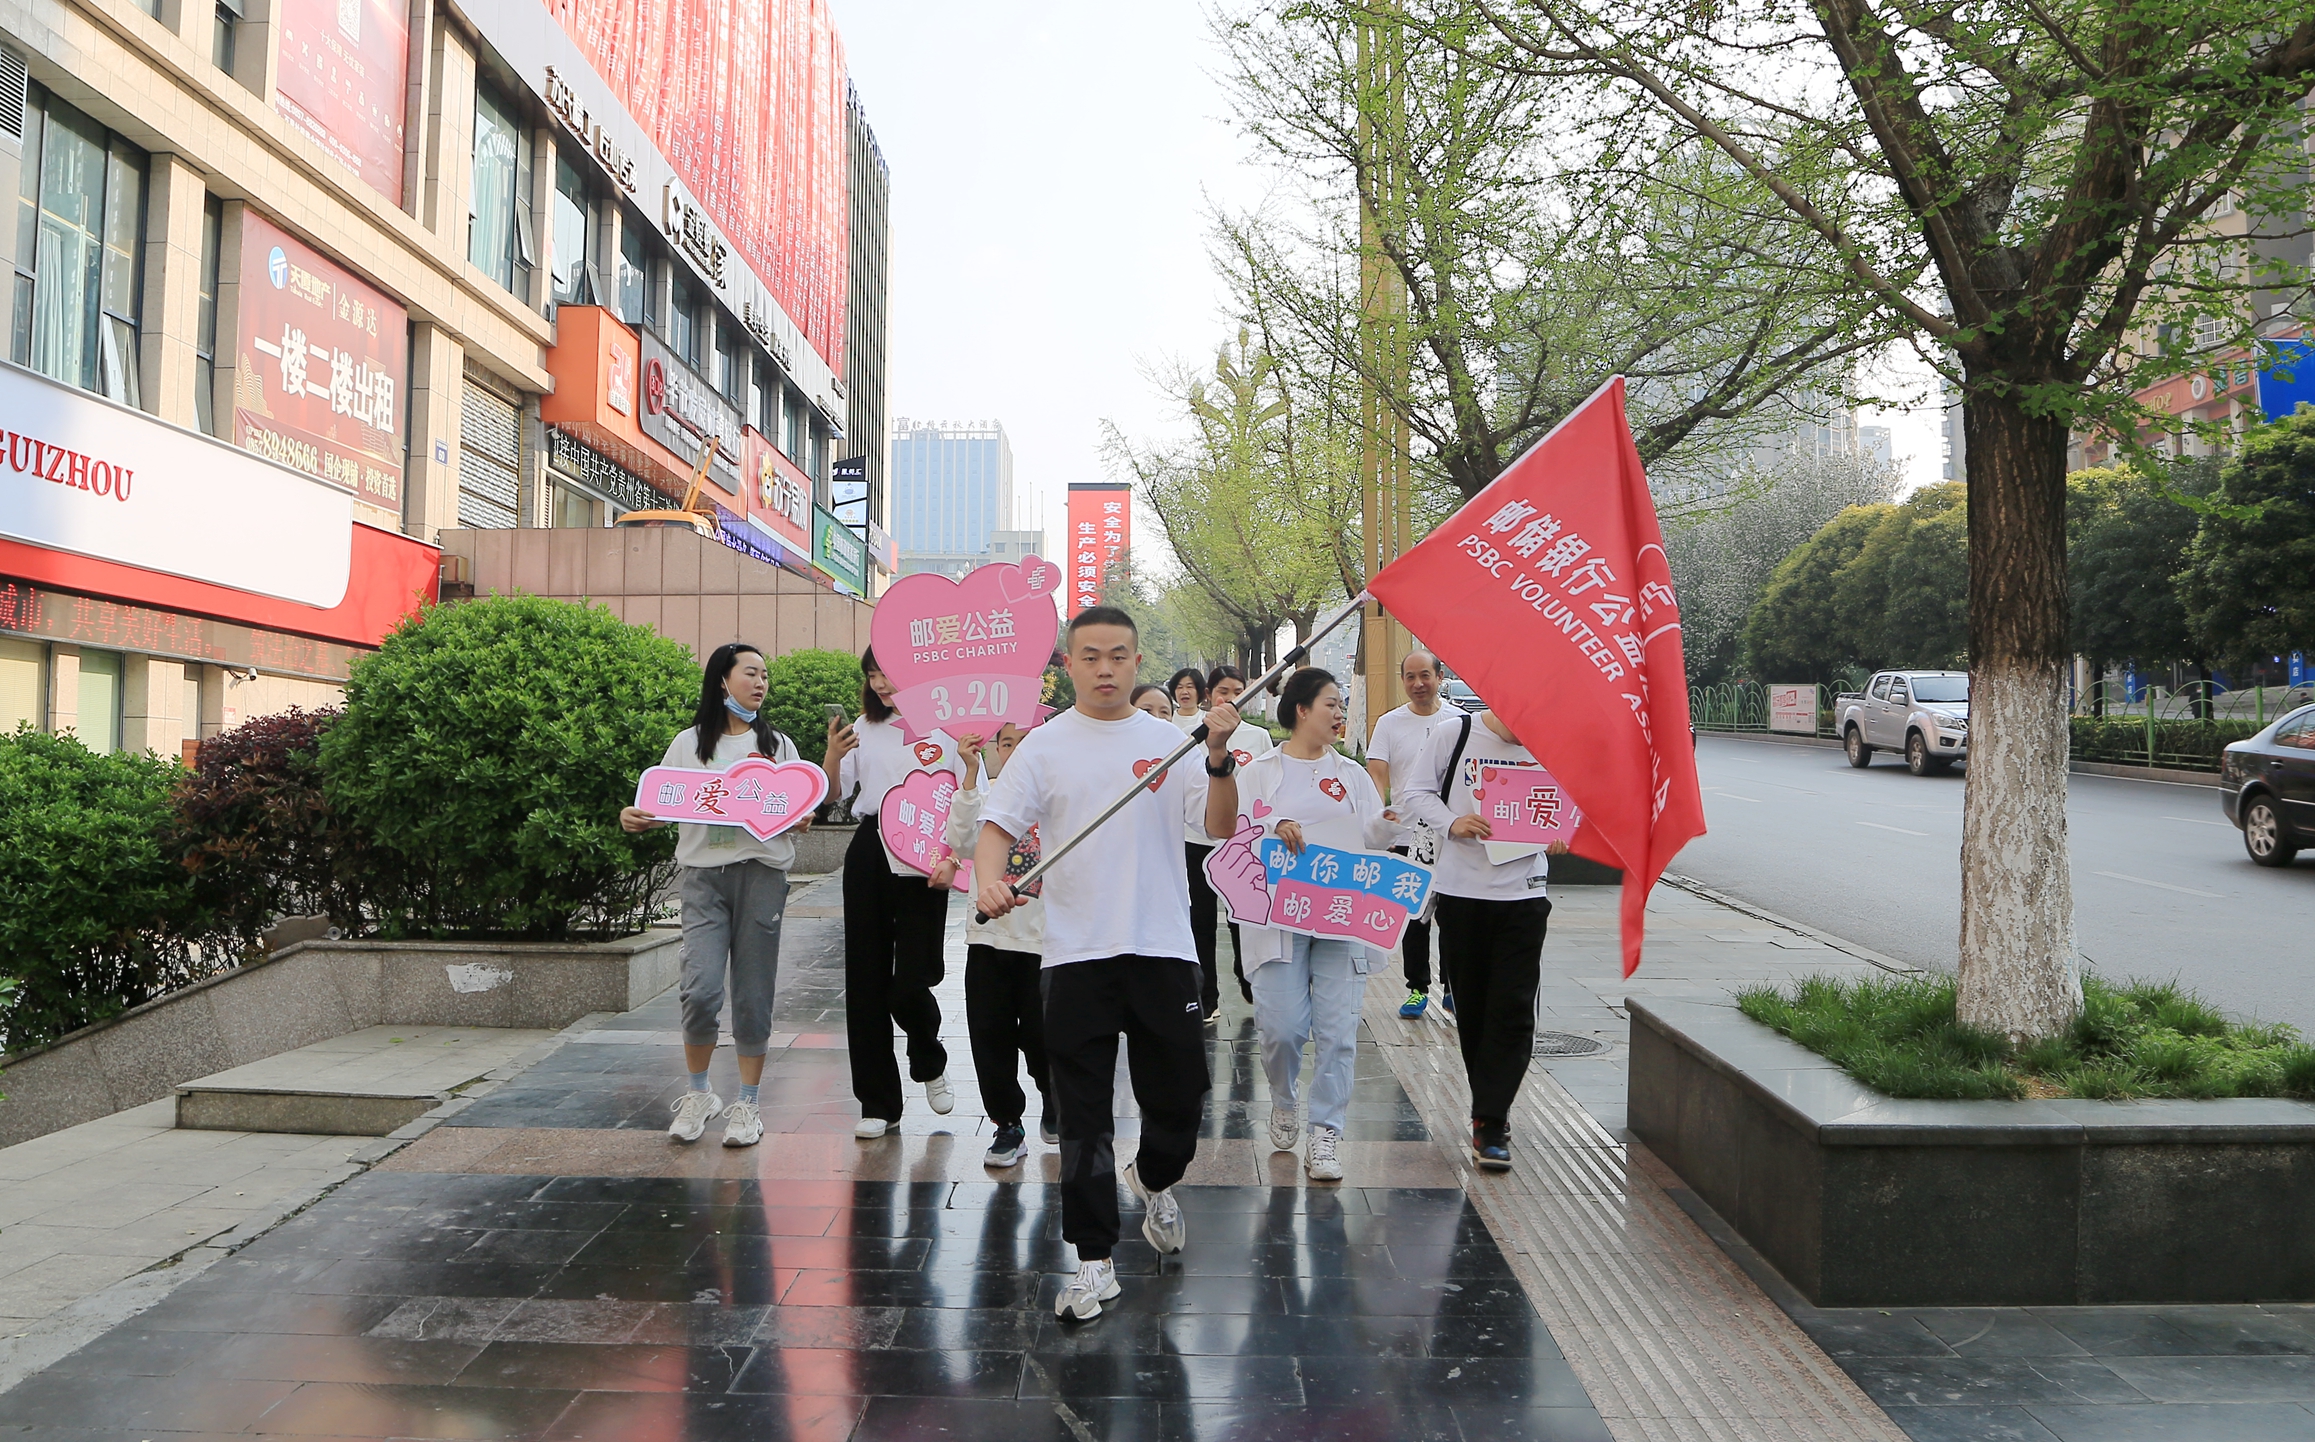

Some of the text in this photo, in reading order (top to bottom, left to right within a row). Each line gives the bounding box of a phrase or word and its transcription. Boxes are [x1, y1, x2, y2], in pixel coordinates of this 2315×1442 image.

[338, 292, 378, 339] 金源达
[254, 322, 395, 435] 一楼二楼出租
[0, 429, 134, 502] UIZHOU
[263, 428, 319, 475] 8948666
[1077, 521, 1098, 609] 生产必须安全
[909, 608, 1016, 648] 邮爱公益
[1457, 533, 1514, 580] PSBC
[1510, 573, 1627, 684] VOLUNTEER
[913, 642, 1018, 664] PSBC CHARITY
[930, 679, 1011, 721] 3.20
[657, 777, 789, 818] 邮爱公益
[1268, 844, 1424, 905] 邮你邮我
[1282, 891, 1396, 932] 邮爱心
